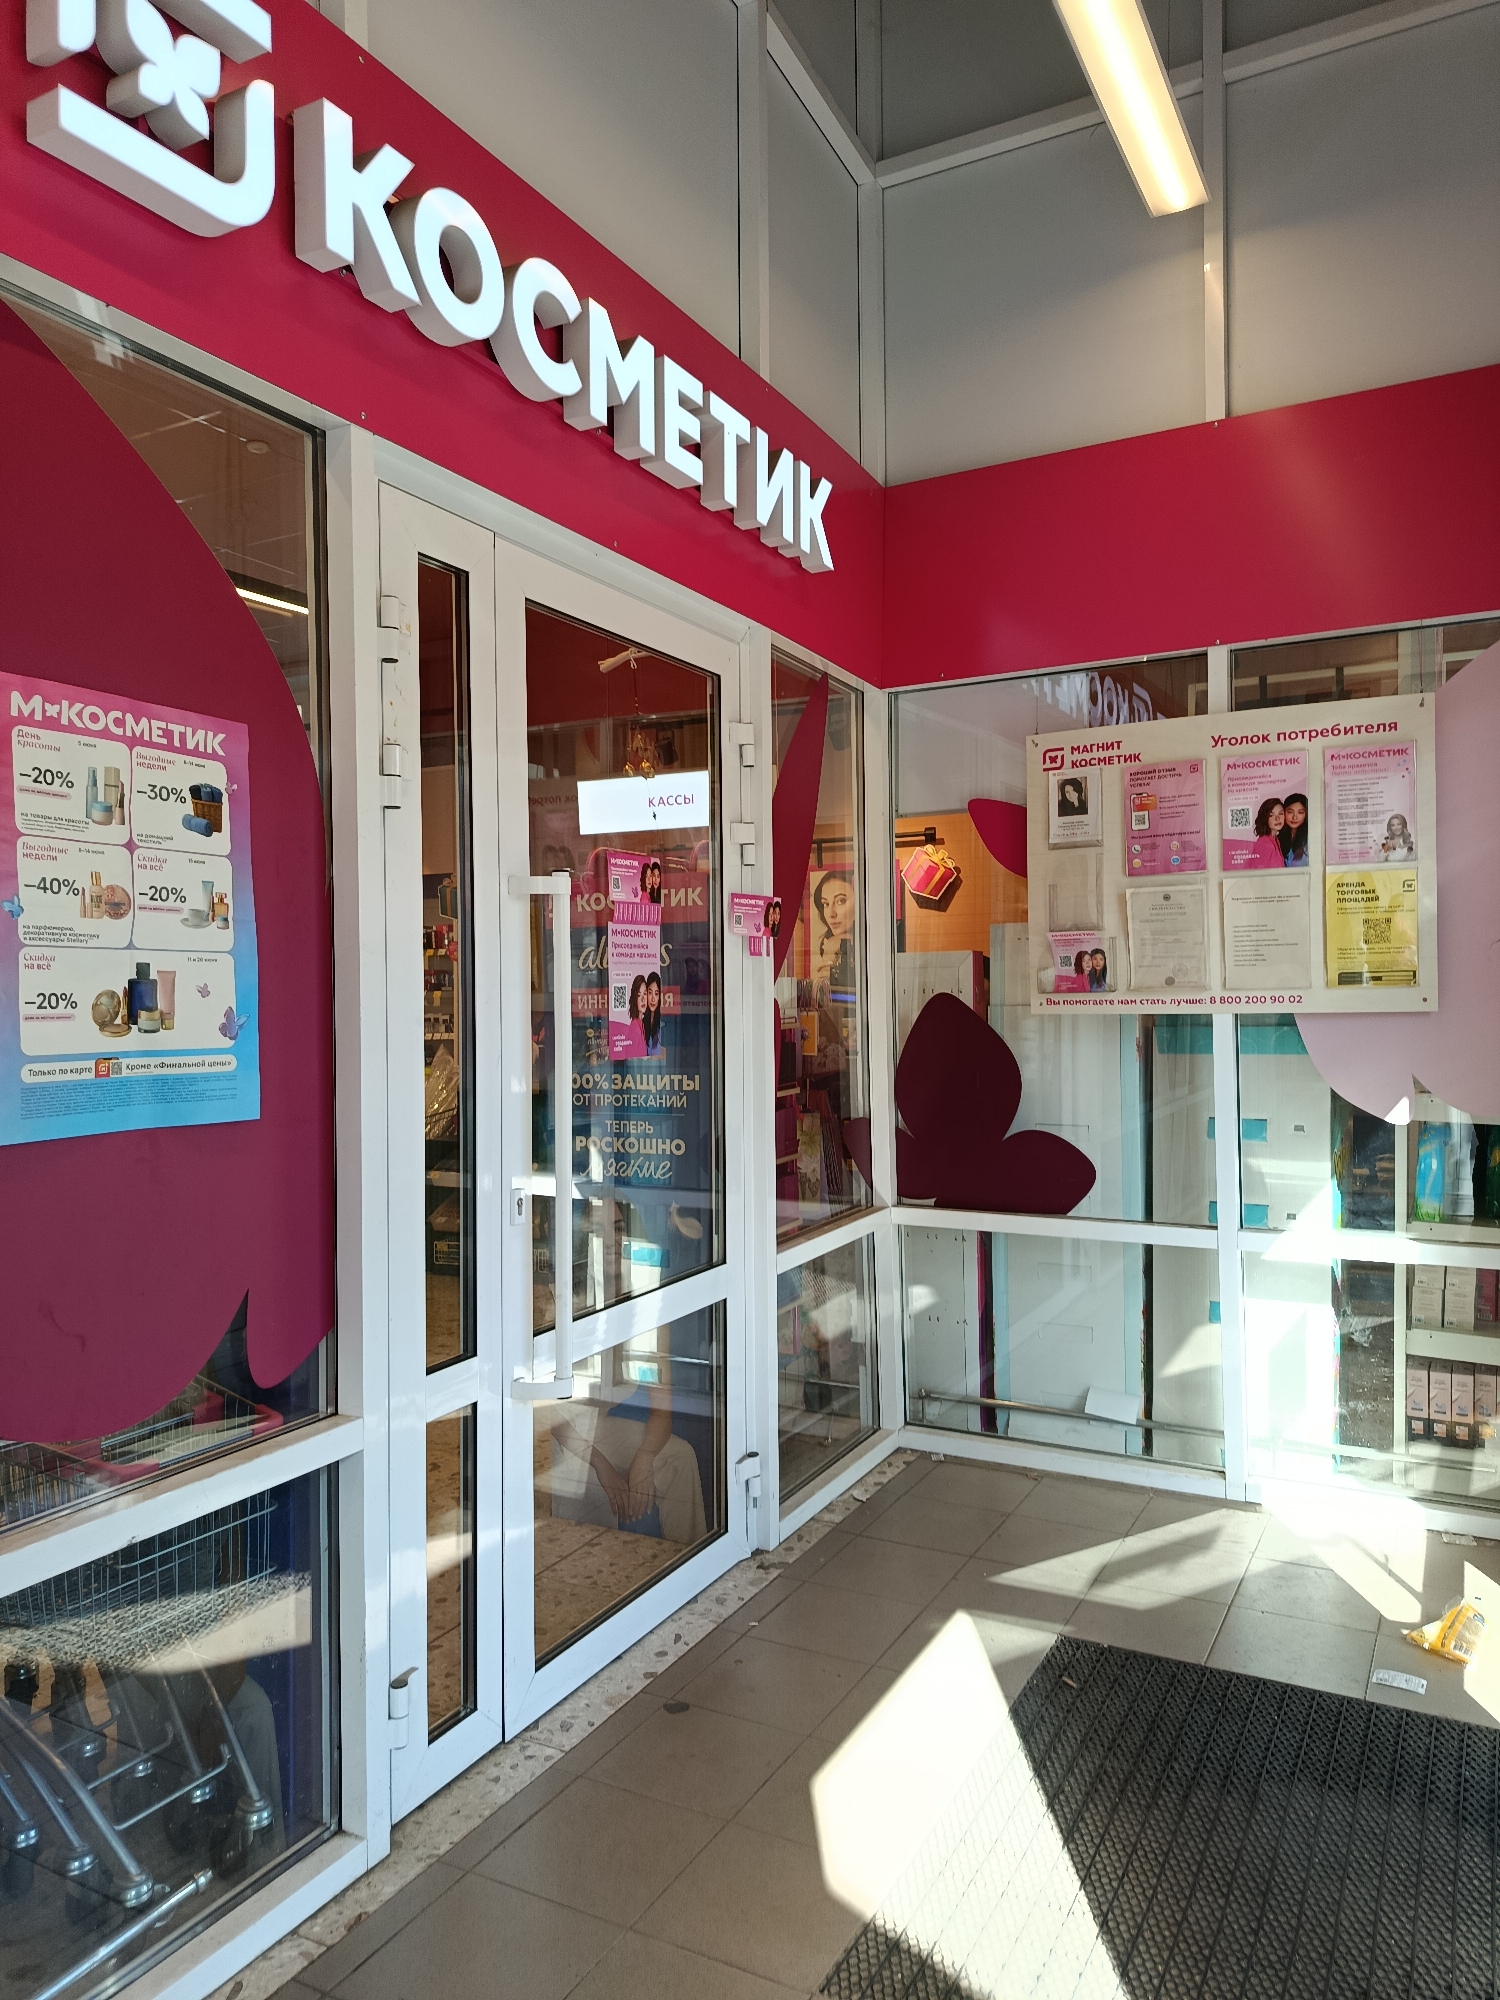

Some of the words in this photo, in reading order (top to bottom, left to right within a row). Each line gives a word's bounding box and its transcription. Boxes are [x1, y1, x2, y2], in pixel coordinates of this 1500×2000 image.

[318, 98, 834, 573] КОСМЕТИК
[16, 729, 41, 740] День
[1210, 732, 1271, 748] Уголок
[1276, 721, 1398, 742] потребителя
[1070, 740, 1123, 755] МАГНИТ
[136, 761, 167, 772] недели
[1070, 753, 1142, 769] КОСМЕТИК
[648, 793, 694, 807] КАССЫ
[22, 841, 69, 855] Выгодные
[22, 852, 58, 861] недели
[137, 853, 168, 864] Скидка
[149, 863, 164, 872] всё
[1336, 881, 1366, 889] АРЕНДА
[576, 886, 704, 914] КОСТИК
[23, 953, 56, 962] Скидка
[36, 962, 52, 970] всё
[1045, 997, 1060, 1006] Вы
[1062, 998, 1115, 1006] помогаете
[1117, 998, 1137, 1006] нам
[1139, 997, 1167, 1005] стать
[1169, 997, 1207, 1007] лучше:
[1209, 996, 1217, 1004] 8
[1219, 996, 1242, 1004] 800
[1244, 995, 1267, 1004] 200
[1269, 995, 1285, 1004] 90
[1288, 995, 1303, 1004] 02
[28, 1068, 57, 1077] Только
[58, 1067, 68, 1075] по
[69, 1067, 93, 1076] карте
[125, 1062, 152, 1072] Кроме
[572, 1073, 609, 1090] 00%
[611, 1073, 700, 1093] ЗАЩИТЫ
[572, 1093, 590, 1106] ОТ
[594, 1092, 687, 1108] ПРОТЕКАНИЙ
[605, 1120, 654, 1134] ТЕПЕРЬ
[575, 1135, 686, 1156] РОСКОШНО
